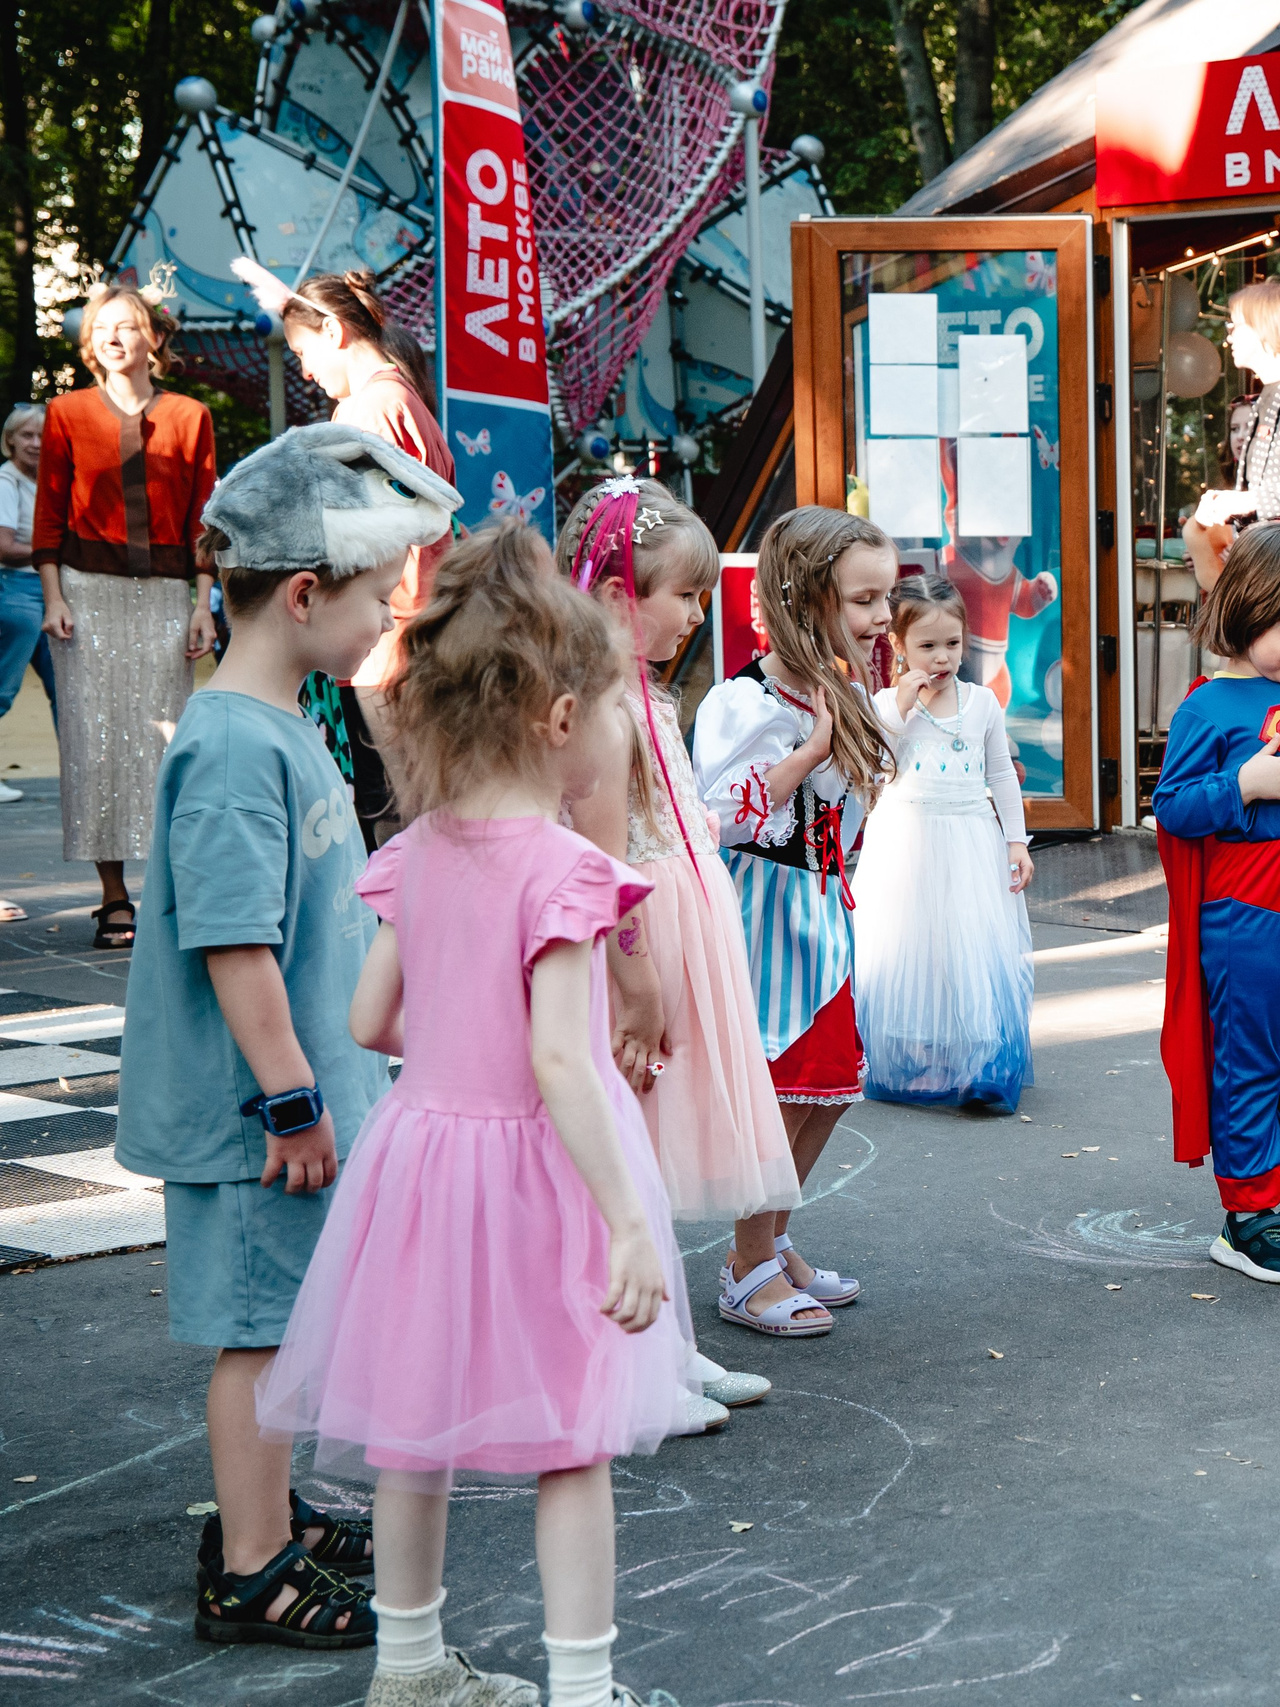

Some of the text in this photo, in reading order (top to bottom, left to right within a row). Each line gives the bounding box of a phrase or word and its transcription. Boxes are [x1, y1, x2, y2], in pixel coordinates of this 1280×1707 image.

[461, 53, 515, 92] райо
[1225, 152, 1250, 187] В
[465, 148, 509, 357] ЛЕТО
[512, 158, 537, 364] В МОСКВЕ
